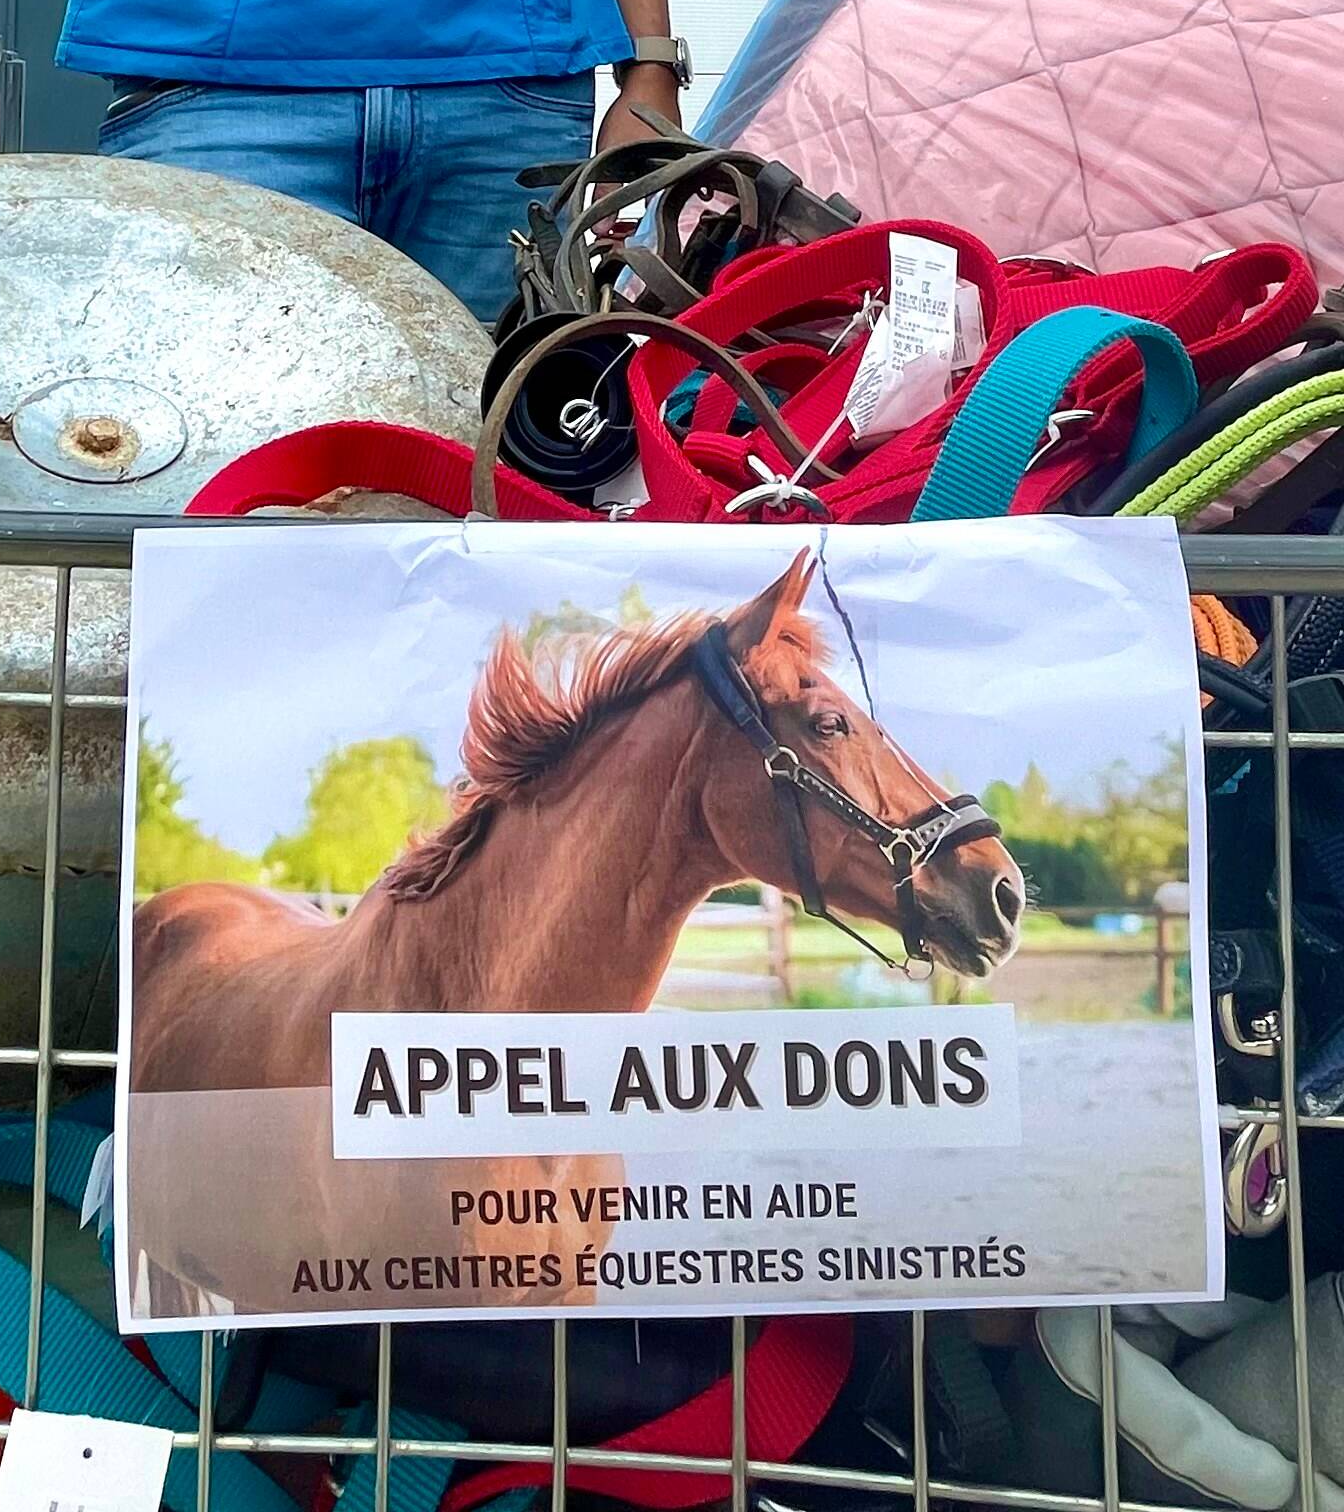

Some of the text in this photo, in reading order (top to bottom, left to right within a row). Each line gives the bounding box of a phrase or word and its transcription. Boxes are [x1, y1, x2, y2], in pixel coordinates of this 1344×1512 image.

[353, 1037, 989, 1117] APPEL AUX DONS
[451, 1183, 858, 1226] POUR VENIR EN AIDE
[291, 1236, 1027, 1294] AUX CENTRES ÉQUESTRES SINISTRÉS
